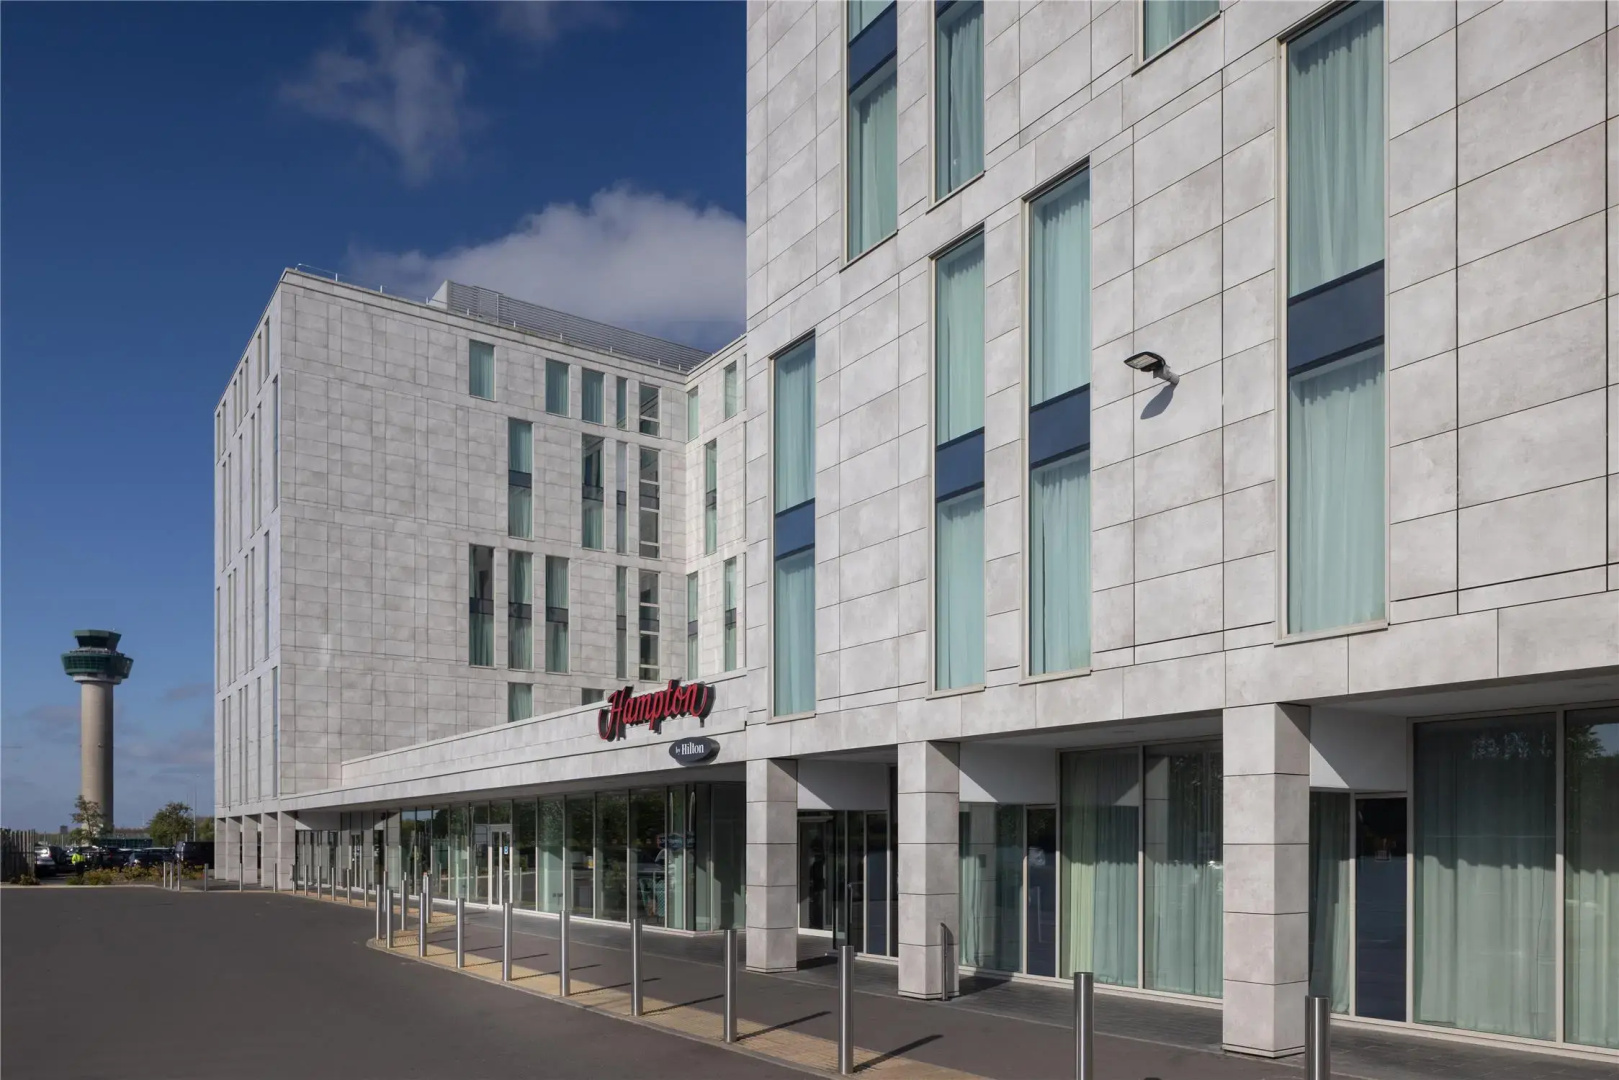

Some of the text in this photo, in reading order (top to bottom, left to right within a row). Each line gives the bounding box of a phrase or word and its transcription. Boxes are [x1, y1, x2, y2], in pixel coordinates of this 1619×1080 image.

[598, 679, 709, 740] Hampton
[675, 741, 704, 755] by Hilton
